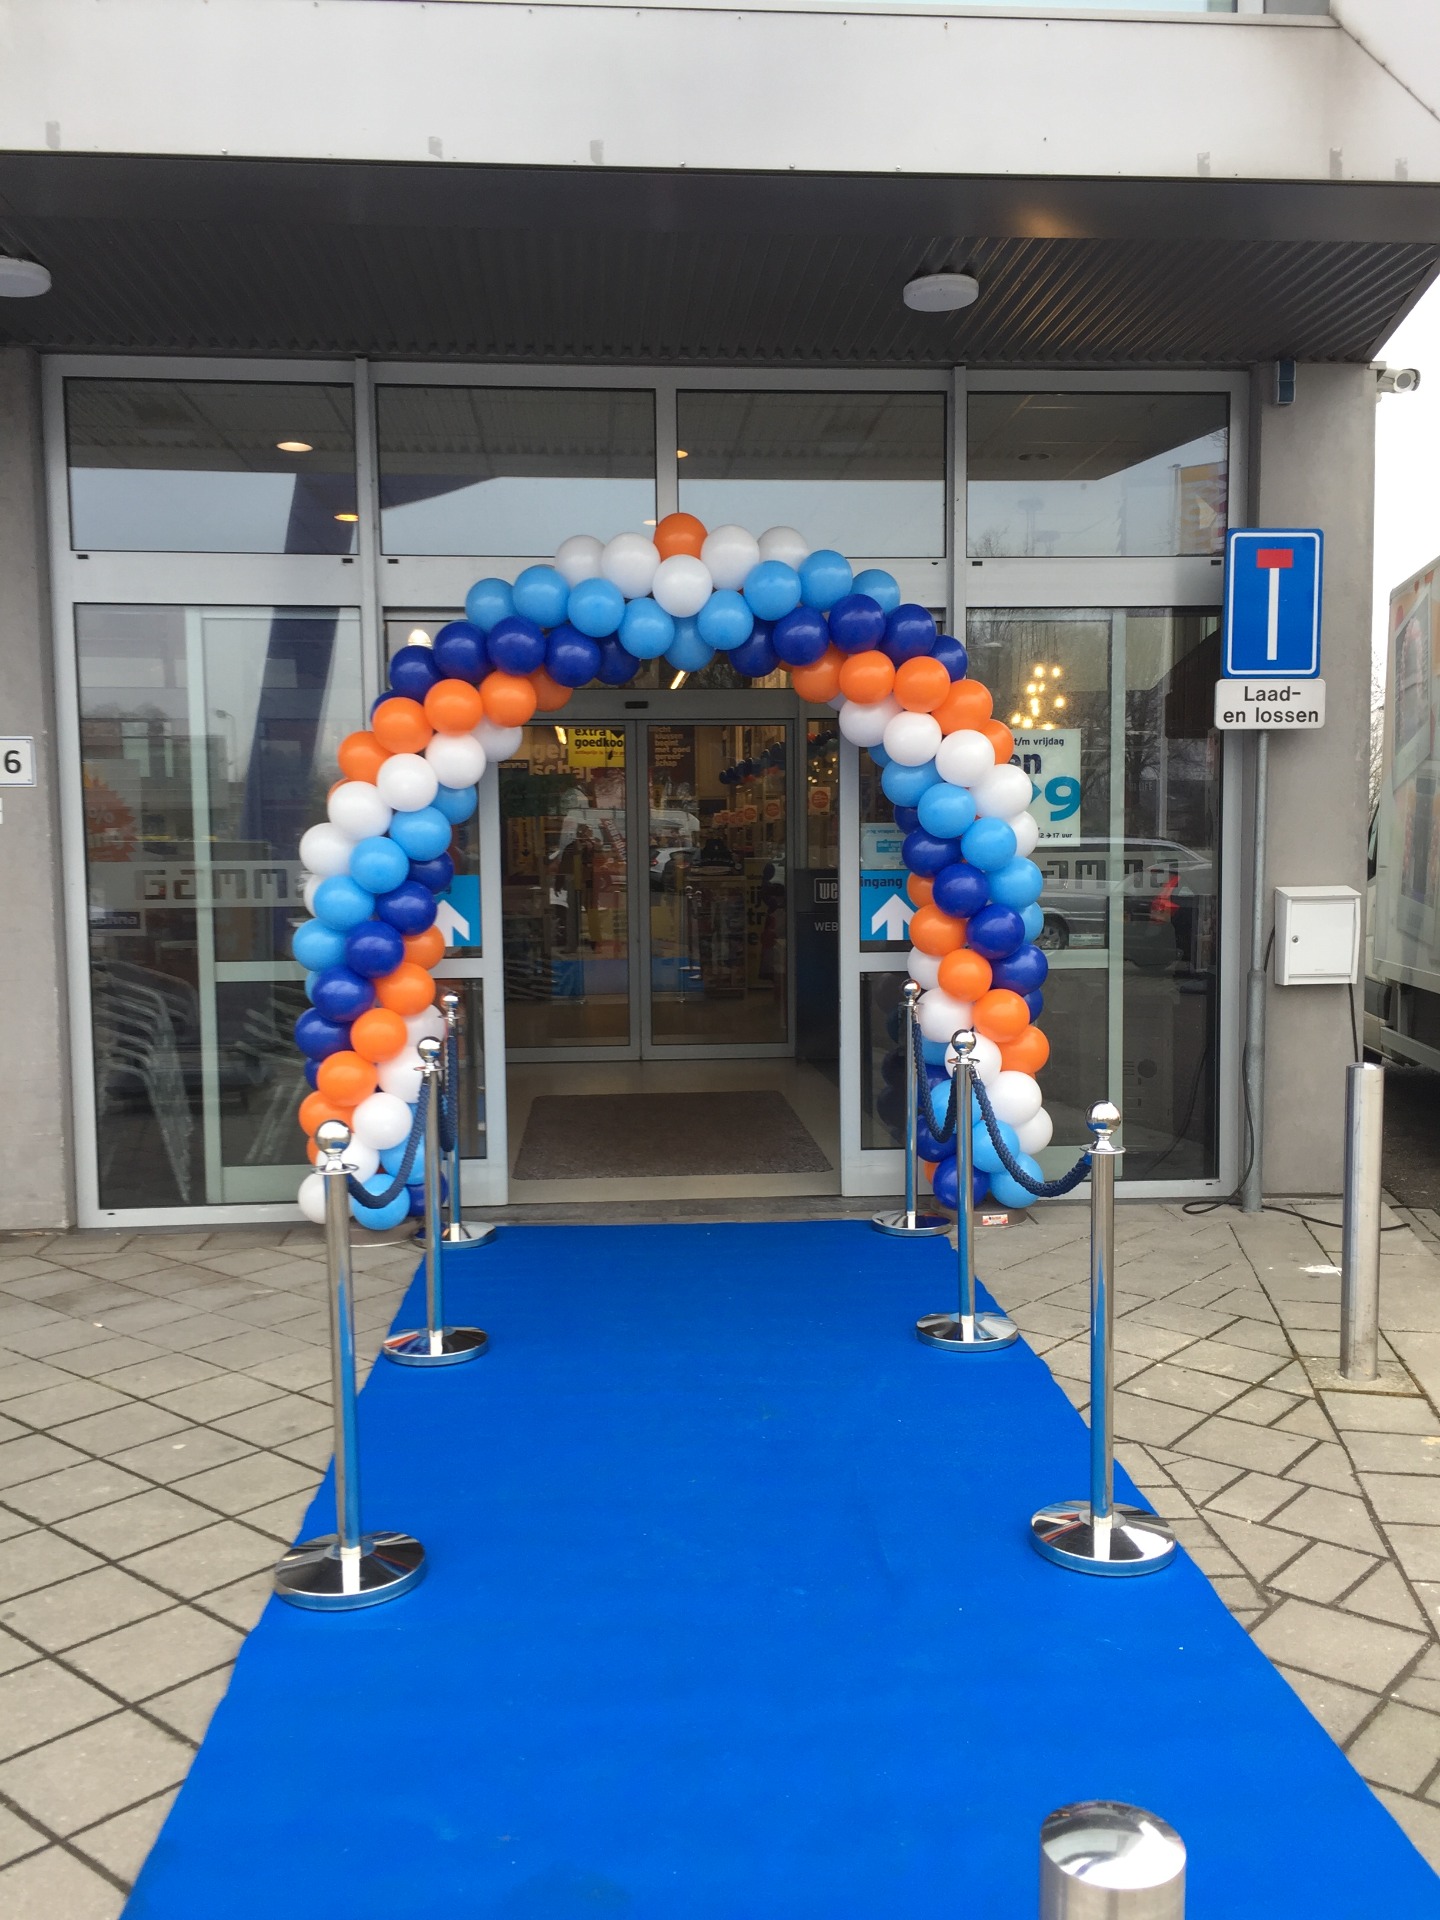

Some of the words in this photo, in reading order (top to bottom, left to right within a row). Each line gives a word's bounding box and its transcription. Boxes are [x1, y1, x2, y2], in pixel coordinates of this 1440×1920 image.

[1243, 685, 1302, 702] Laad-
[1222, 710, 1247, 723] en
[1255, 706, 1319, 723] lossen
[574, 729, 606, 737] extra
[1033, 737, 1065, 747] vrijdag
[1044, 775, 1081, 822] 9
